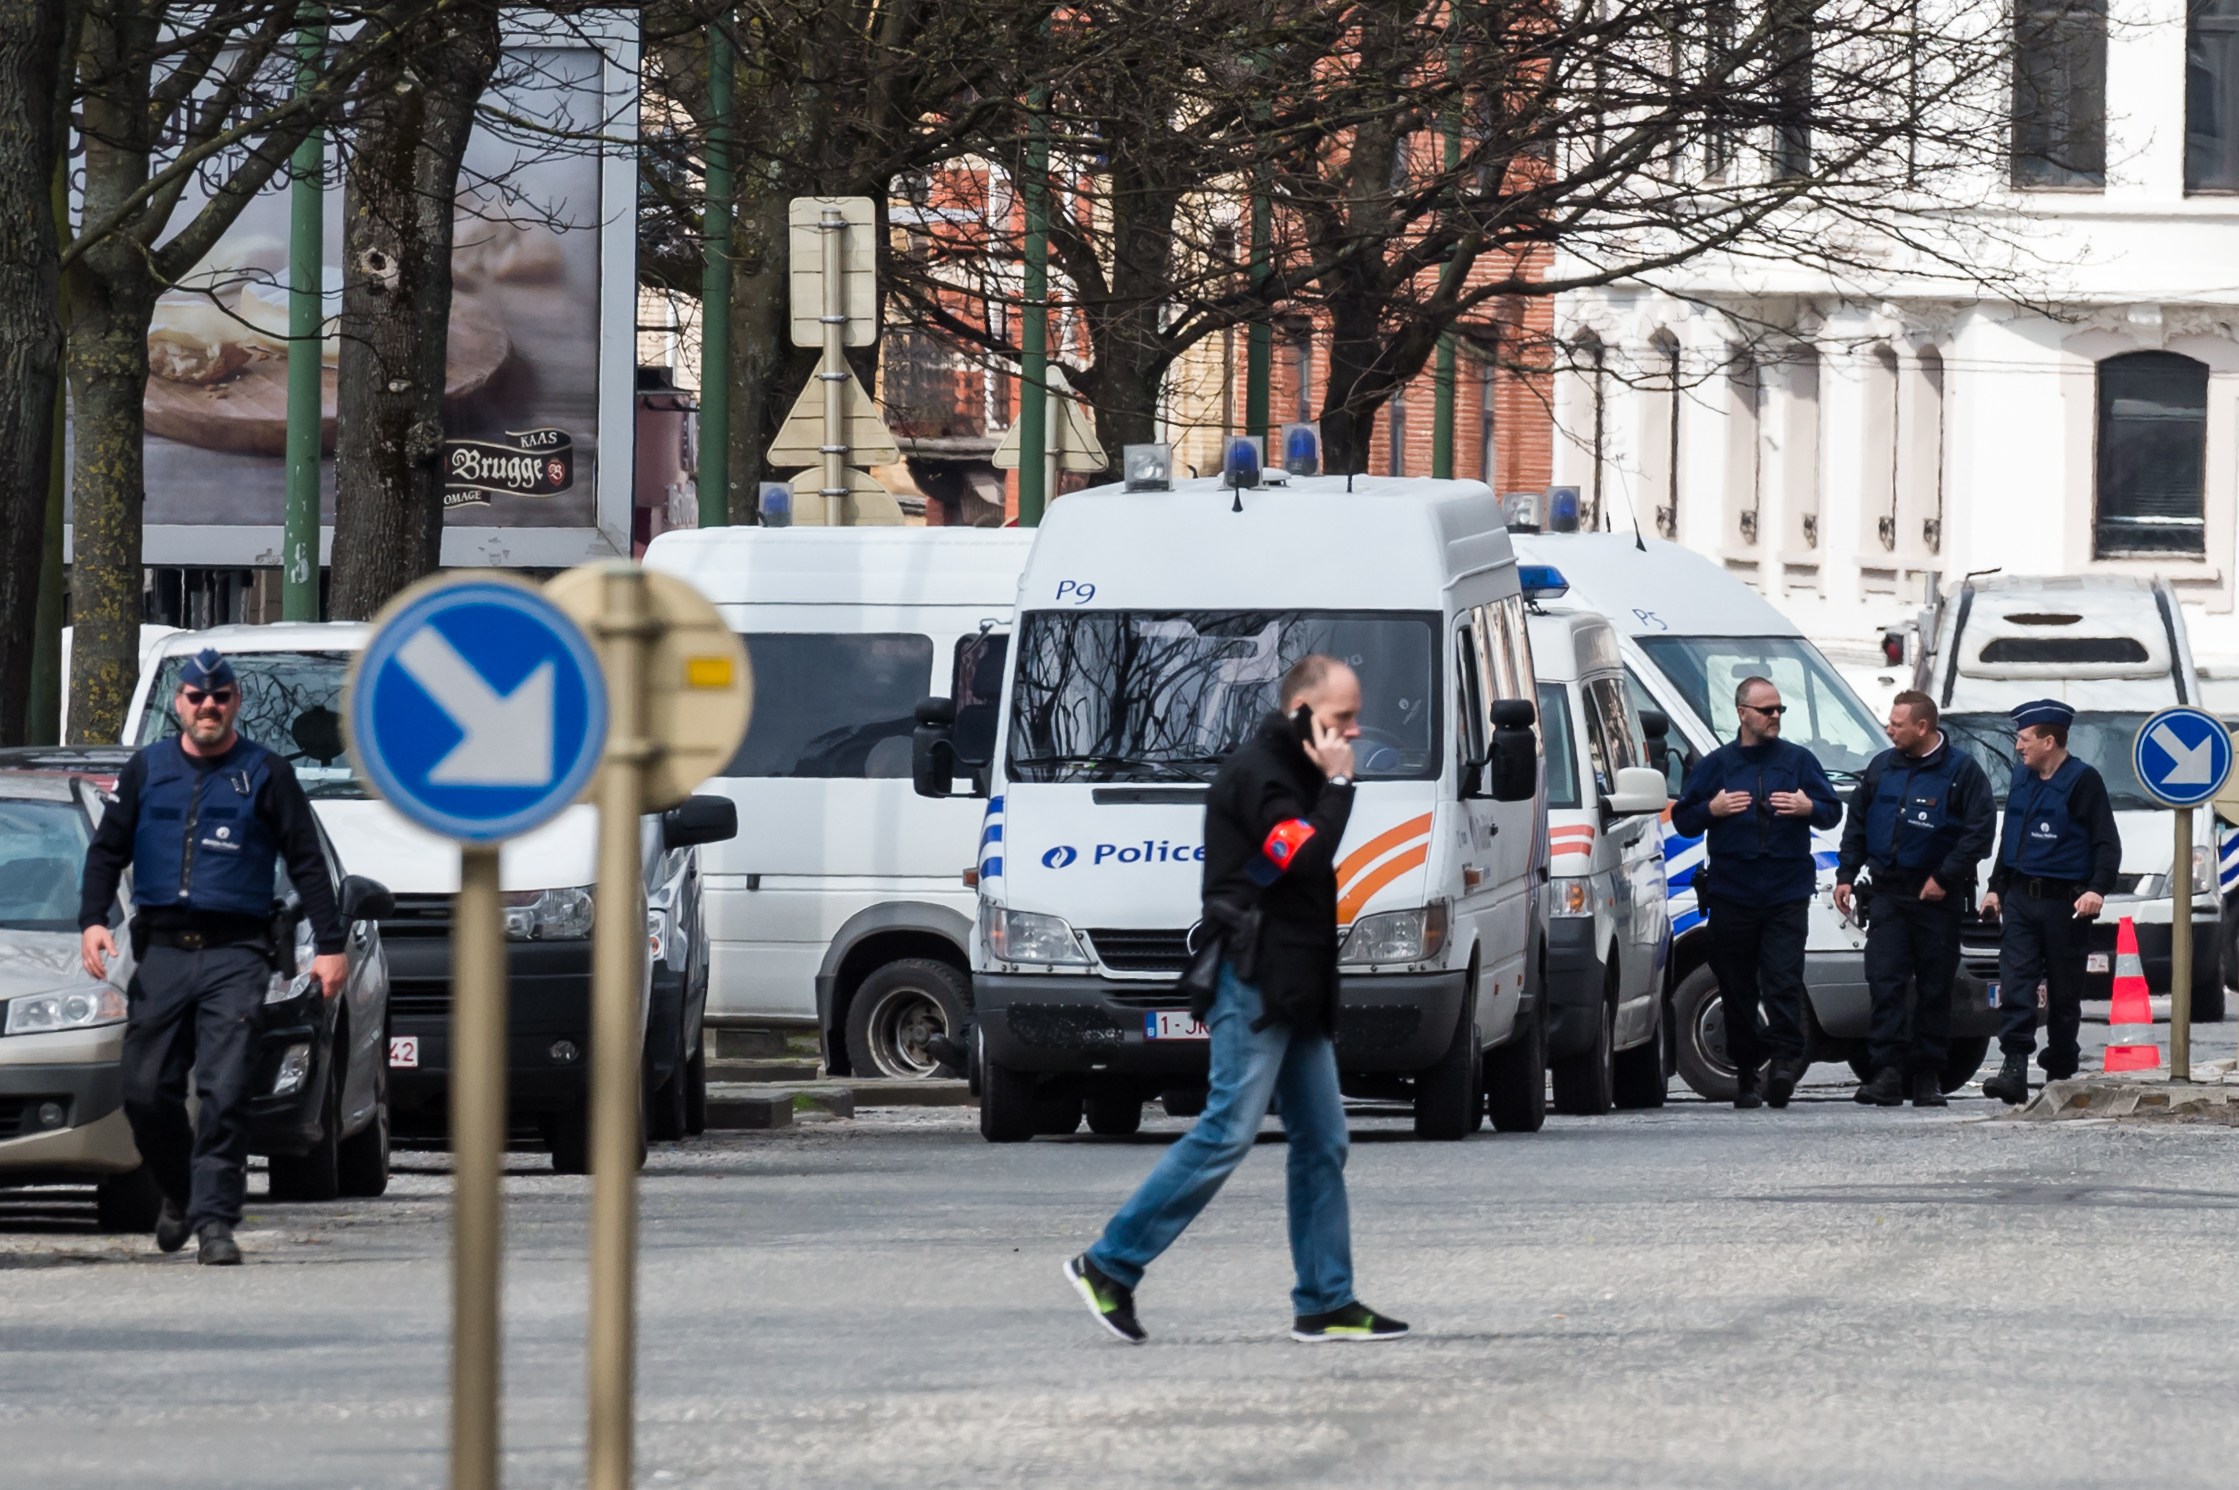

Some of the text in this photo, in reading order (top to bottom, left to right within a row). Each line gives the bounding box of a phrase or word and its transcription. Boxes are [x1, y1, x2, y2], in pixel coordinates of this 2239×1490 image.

[520, 432, 558, 448] KAAS
[451, 448, 543, 488] Brugge
[1056, 580, 1096, 605] P9
[1631, 608, 1668, 631] P5
[1093, 840, 1205, 866] Police
